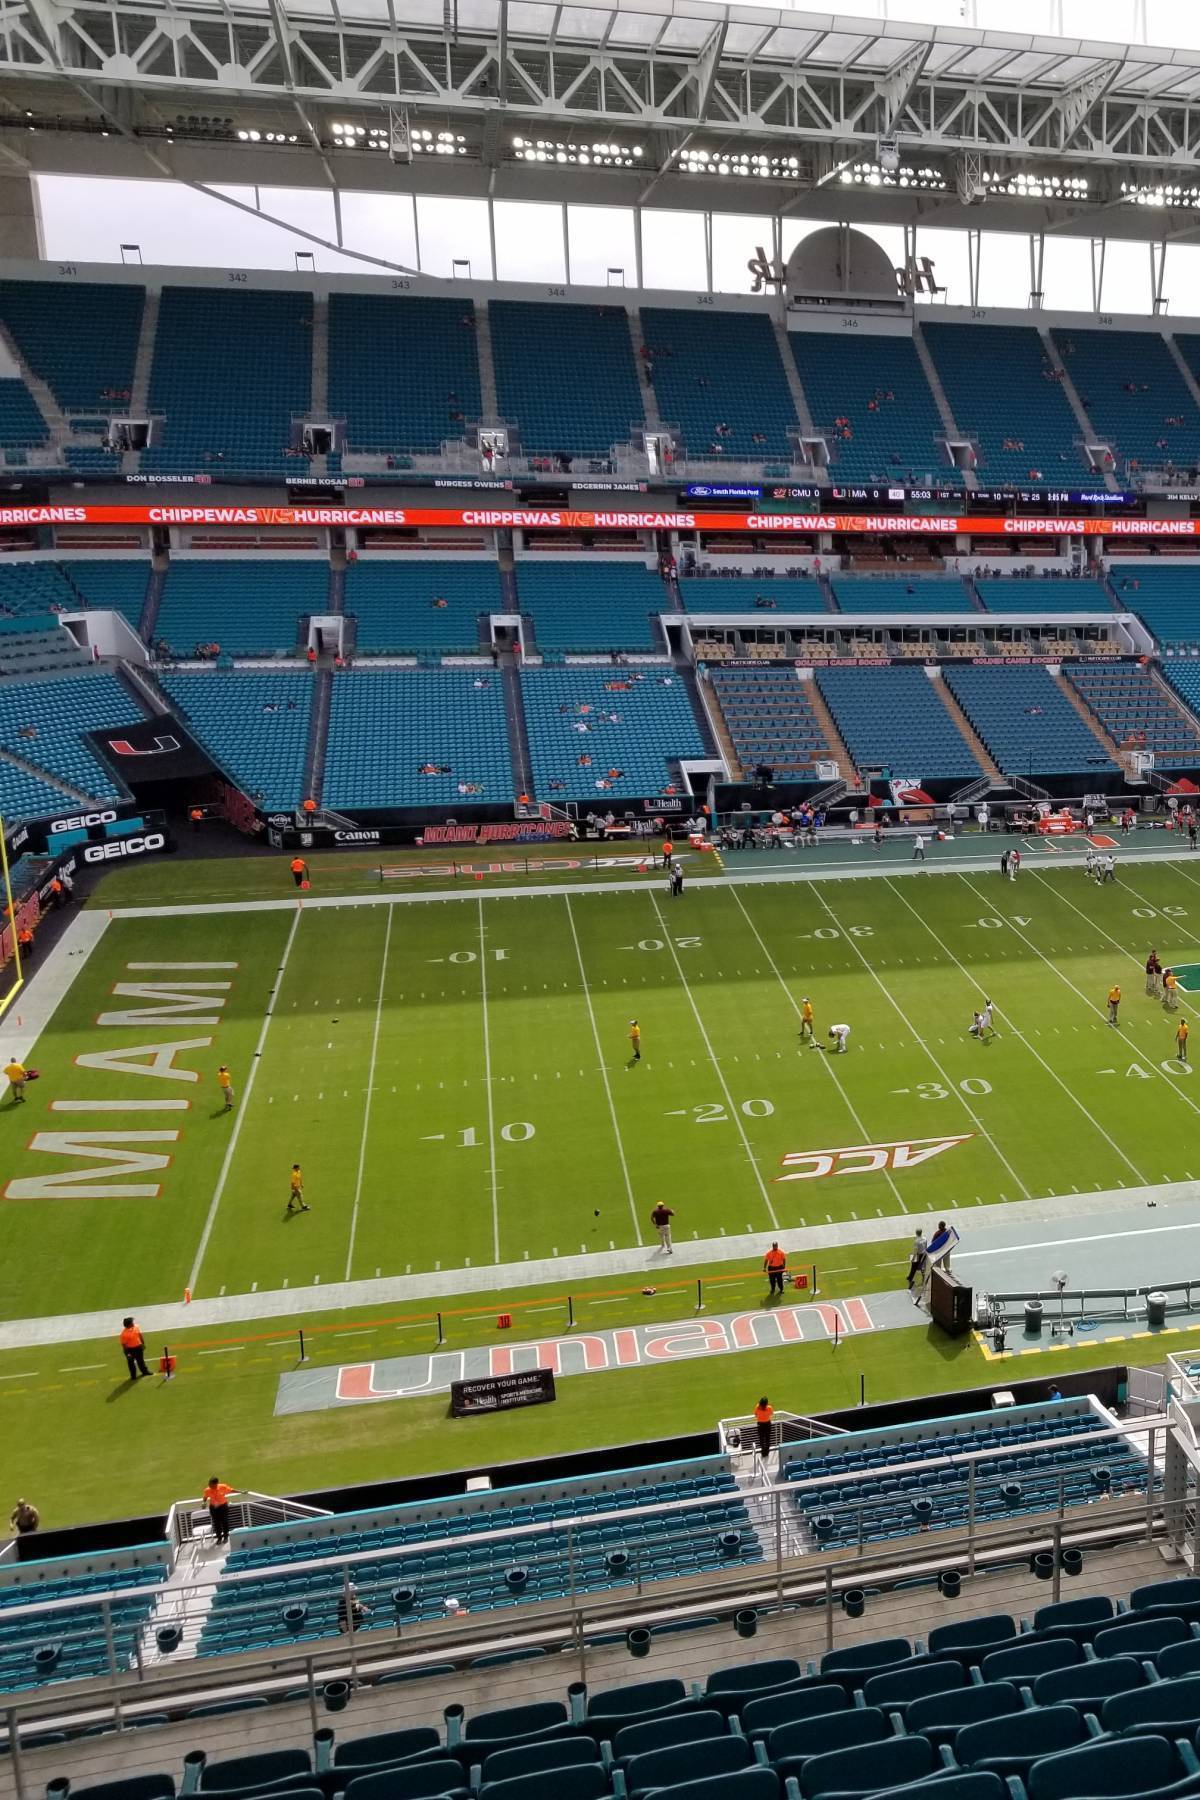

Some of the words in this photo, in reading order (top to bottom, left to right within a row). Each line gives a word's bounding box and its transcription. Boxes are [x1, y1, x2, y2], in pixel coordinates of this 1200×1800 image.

[58, 266, 77, 276] 341
[228, 272, 248, 283] 342
[392, 279, 410, 290] 343
[547, 287, 566, 297] 344
[697, 296, 714, 305] 345
[842, 319, 858, 328] 346
[148, 475, 194, 483] BOSSELER
[286, 477, 317, 485] BERNIE
[318, 478, 348, 486] KOSAR
[435, 480, 473, 488] BURGESS
[474, 481, 505, 489] OWENS
[572, 482, 612, 490] EDGERRIN
[613, 483, 640, 491] JAMES
[791, 489, 811, 497] CMU
[851, 490, 867, 498] MIA
[873, 490, 879, 498] 0
[911, 490, 931, 499] 55:03
[1031, 493, 1040, 501] 25
[149, 507, 257, 521] CHIPPEWAS
[294, 509, 405, 523] HURRICANES
[462, 511, 560, 525] CHIPPEWAS
[594, 512, 695, 527] HURRICANES
[747, 516, 836, 529] CHIPPEWAS
[866, 517, 957, 531] HURRICANES
[1004, 519, 1085, 532] CHIPPEWAS
[1112, 521, 1195, 533] HURRICANES
[794, 659, 829, 667] GOLDEN
[830, 658, 857, 666] CANES
[858, 658, 892, 666] SOCIETY
[972, 657, 1004, 665] GOLDEN
[1032, 656, 1063, 664] SOCIETY
[51, 810, 117, 834] GEICO
[334, 830, 380, 841] Canon
[424, 825, 478, 843] MIAMI
[478, 822, 571, 841] HURRICANES
[84, 833, 165, 863] GEICO
[1124, 1057, 1194, 1080] 40
[2, 961, 239, 1200] MIAMI
[916, 1076, 994, 1101] 30
[694, 1098, 775, 1123] 20
[456, 1121, 536, 1147] 10
[771, 1133, 976, 1183] ACC
[463, 1383, 496, 1394] RECOVER
[496, 1379, 517, 1389] YOUR
[500, 1391, 519, 1399] SPORTS
